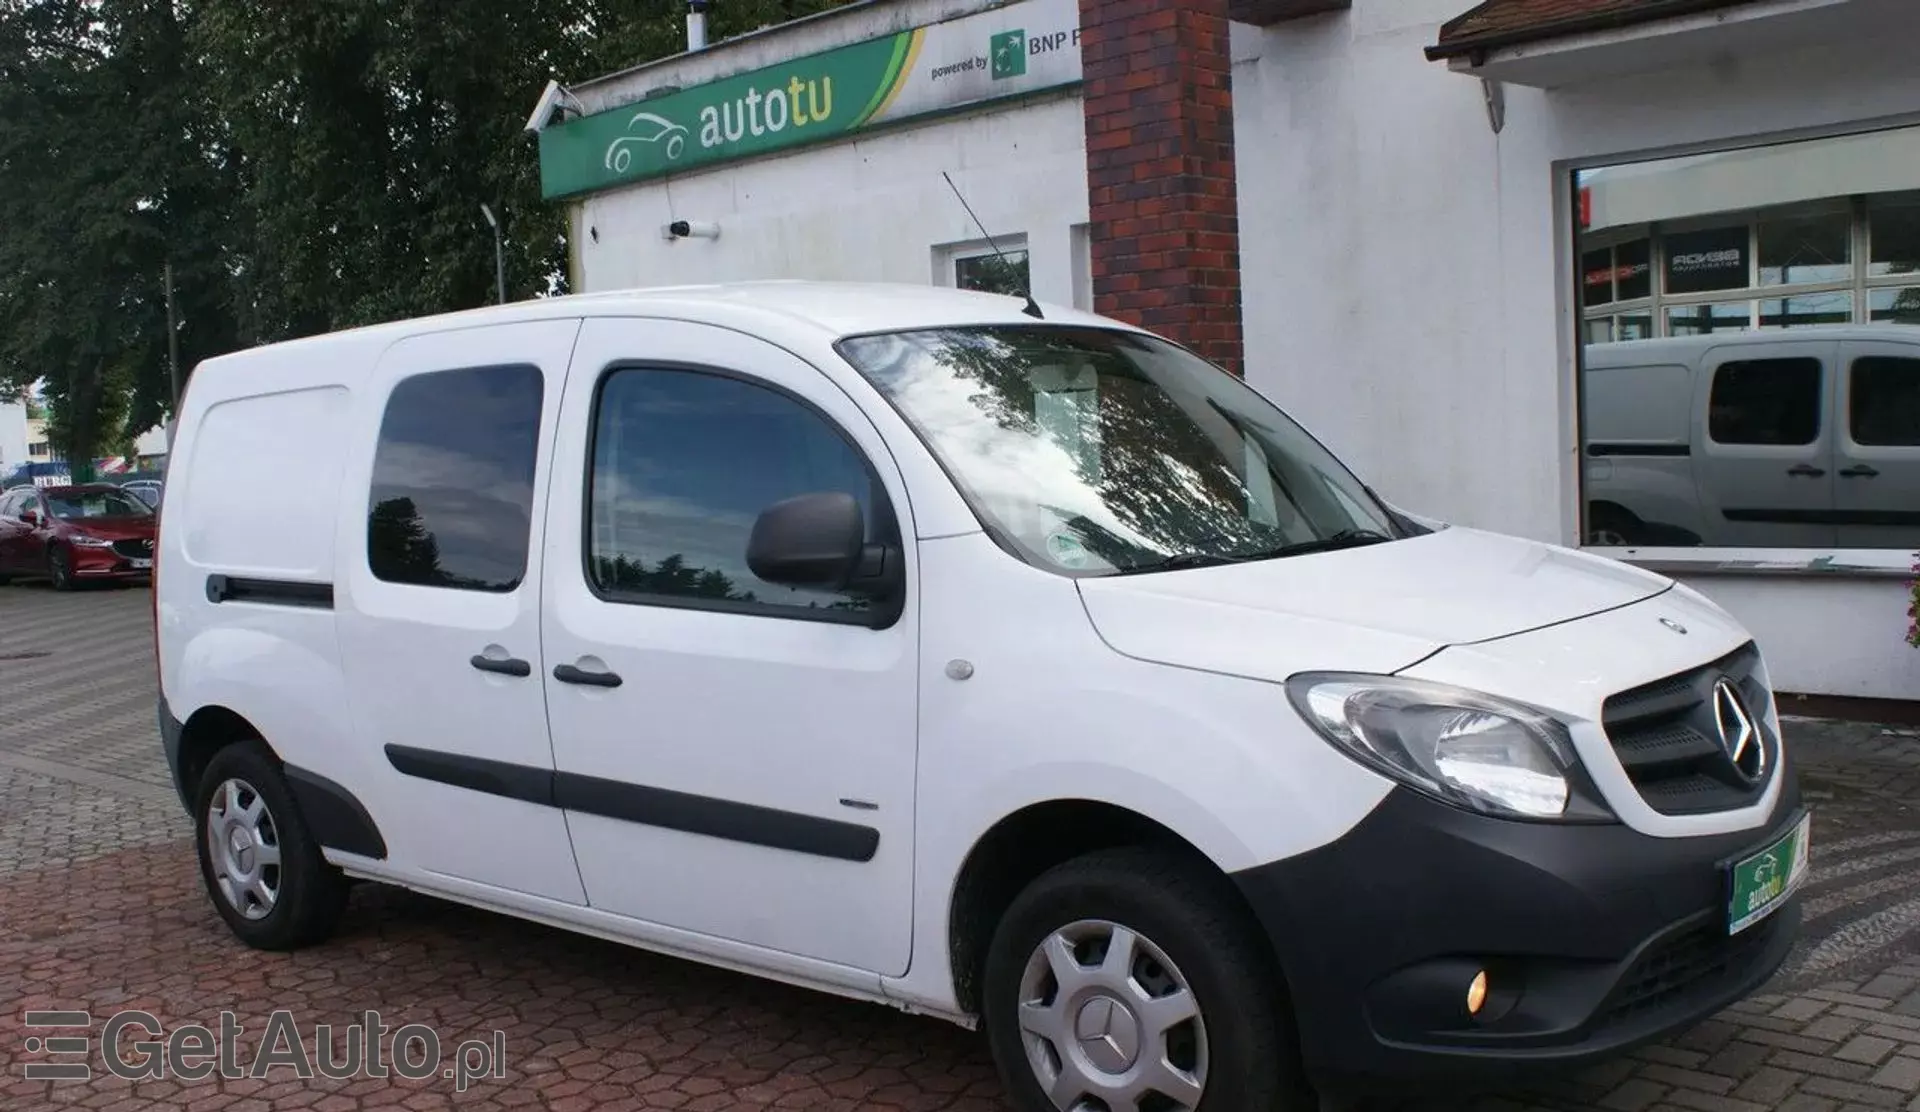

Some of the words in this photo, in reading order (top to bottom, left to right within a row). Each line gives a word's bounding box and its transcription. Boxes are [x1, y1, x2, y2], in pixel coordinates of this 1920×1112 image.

[1029, 32, 1066, 55] BNP
[931, 58, 973, 80] powered
[976, 55, 988, 70] by
[700, 76, 831, 148] autotu
